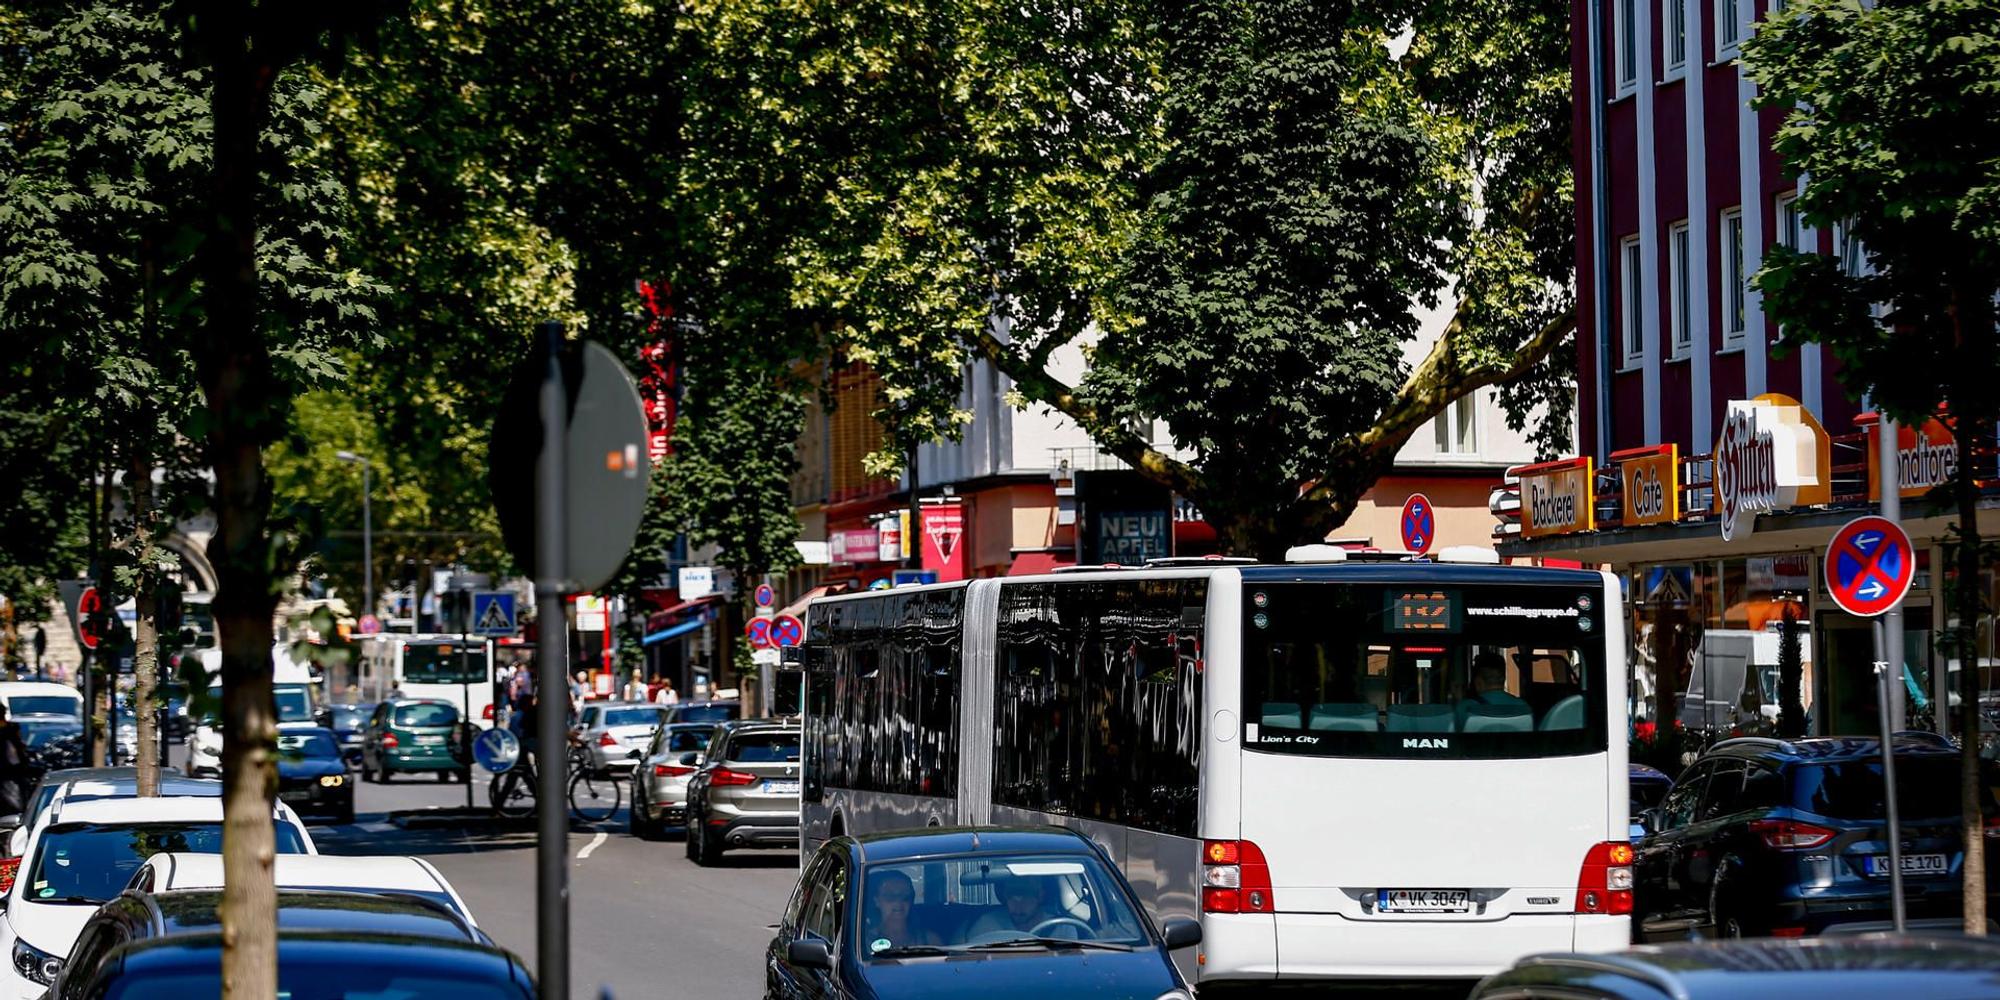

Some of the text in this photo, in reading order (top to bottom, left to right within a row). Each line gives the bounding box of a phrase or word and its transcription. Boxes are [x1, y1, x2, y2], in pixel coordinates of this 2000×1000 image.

[1634, 466, 1663, 516] Cafe
[1532, 481, 1577, 527] Bäckerei
[1101, 516, 1164, 537] NEU!
[1104, 538, 1164, 554] APFEL
[1467, 606, 1579, 618] www.schillinggruppe.de
[1260, 735, 1320, 745] Lion's City
[1403, 738, 1449, 749] MAN
[1388, 891, 1466, 906] K VK 3047
